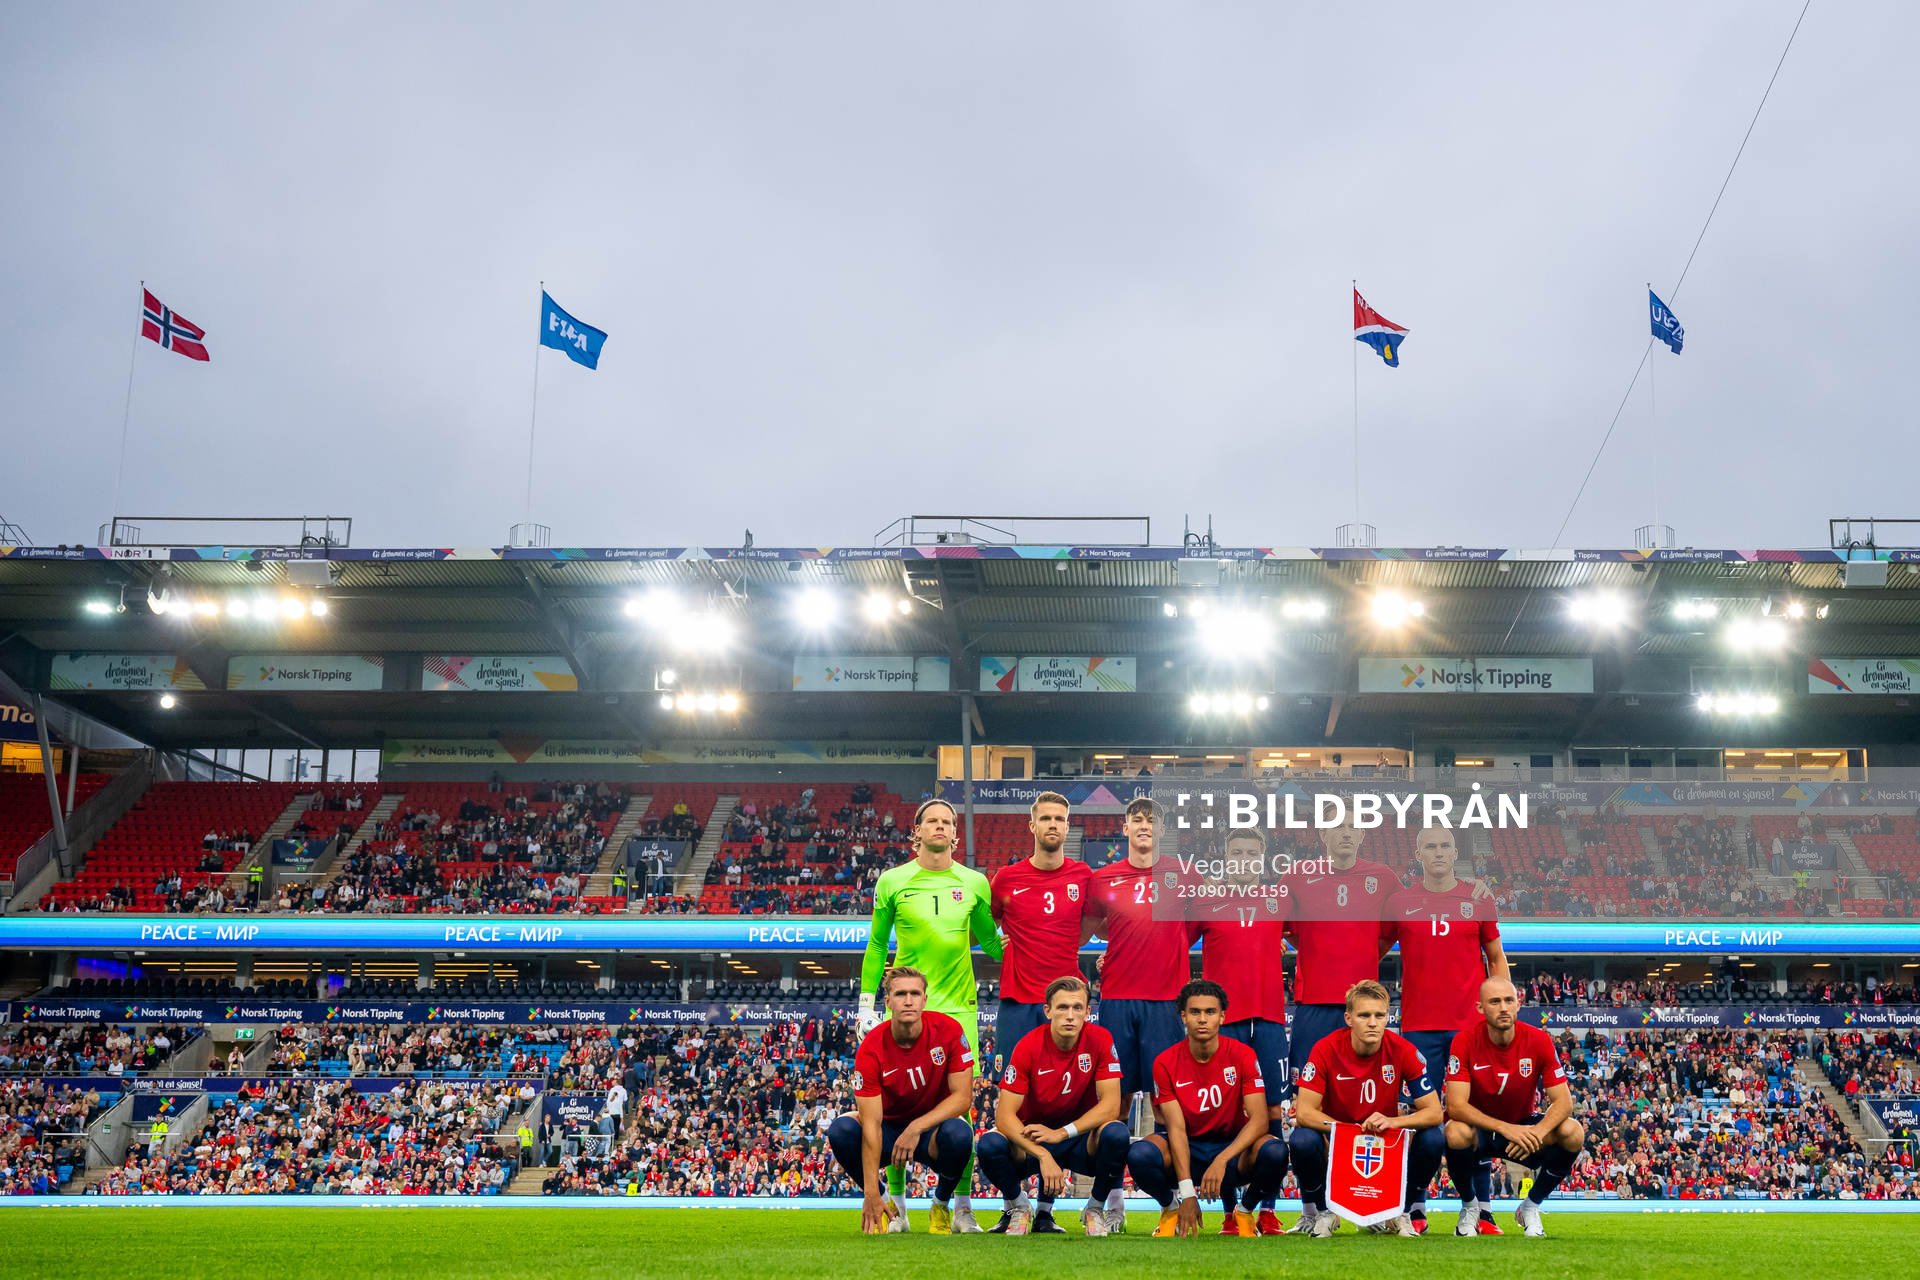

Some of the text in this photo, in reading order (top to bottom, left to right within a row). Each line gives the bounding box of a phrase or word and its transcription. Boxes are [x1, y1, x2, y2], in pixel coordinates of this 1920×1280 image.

[550, 312, 587, 351] FIFA
[121, 657, 131, 667] Gi
[493, 658, 501, 668] Gi
[1049, 658, 1058, 668] Gi
[1876, 661, 1885, 671] Gi
[106, 661, 147, 679] drømmen
[278, 668, 352, 682] Norsk Tipping
[477, 662, 518, 679] drømmen
[844, 669, 919, 683] Norsk Tipping
[1034, 662, 1075, 680] drømmen
[1863, 665, 1903, 683] drømmen
[113, 673, 153, 689] en sjanse!
[485, 674, 524, 689] en sjanse!
[1042, 674, 1082, 690] en sjanse!
[1432, 668, 1553, 689] Norsk Tipping
[1871, 678, 1911, 693] en sjanse!
[429, 746, 495, 758] Norsk Tipping
[980, 789, 1010, 798] Norsk
[1550, 789, 1588, 802] Tipping
[1673, 788, 1685, 800] Gi
[1742, 788, 1775, 803] sjanse!
[1878, 790, 1907, 800] Norsk
[1134, 882, 1159, 905] 23
[1337, 884, 1348, 907] 8
[933, 896, 939, 915] 1
[1044, 892, 1055, 914] 3
[1237, 907, 1257, 927] 17
[1430, 914, 1450, 937] 15
[141, 926, 260, 941] PEACE МИР
[445, 927, 563, 942] PEACE МИР
[749, 928, 866, 943] PEACE МИР
[1665, 931, 1783, 946] PEACE МИР
[39, 1008, 101, 1019] Norsk Tipping
[141, 1008, 203, 1019] Norsk Tipping
[241, 1008, 303, 1019] Norsk Tipping
[342, 1008, 404, 1019] Norsk Tipping
[443, 1009, 505, 1020] Norsk Tipping
[544, 1009, 606, 1020] Norsk Tipping
[645, 1009, 706, 1021] Norsk Tipping
[746, 1010, 808, 1021] Norsk Tipping
[1556, 1014, 1618, 1025] Norsk Tipping
[1658, 1014, 1720, 1025] Norsk Tipping
[1759, 1014, 1821, 1025] Norsk Tipping
[1860, 1014, 1920, 1025] Norsk Tipping
[1278, 1058, 1290, 1082] 17
[165, 1081, 175, 1089] en
[176, 1079, 203, 1090] sjanse!
[907, 1066, 927, 1091] 11
[1061, 1071, 1072, 1095] 2
[1420, 1077, 1432, 1091] C
[1498, 1073, 1509, 1096] 7
[1197, 1084, 1223, 1112] 20
[1359, 1079, 1376, 1105] 10
[559, 1102, 589, 1115] drømmen
[570, 1098, 577, 1107] Gi
[1893, 1102, 1900, 1111] Gi
[1883, 1106, 1913, 1120] drømmen
